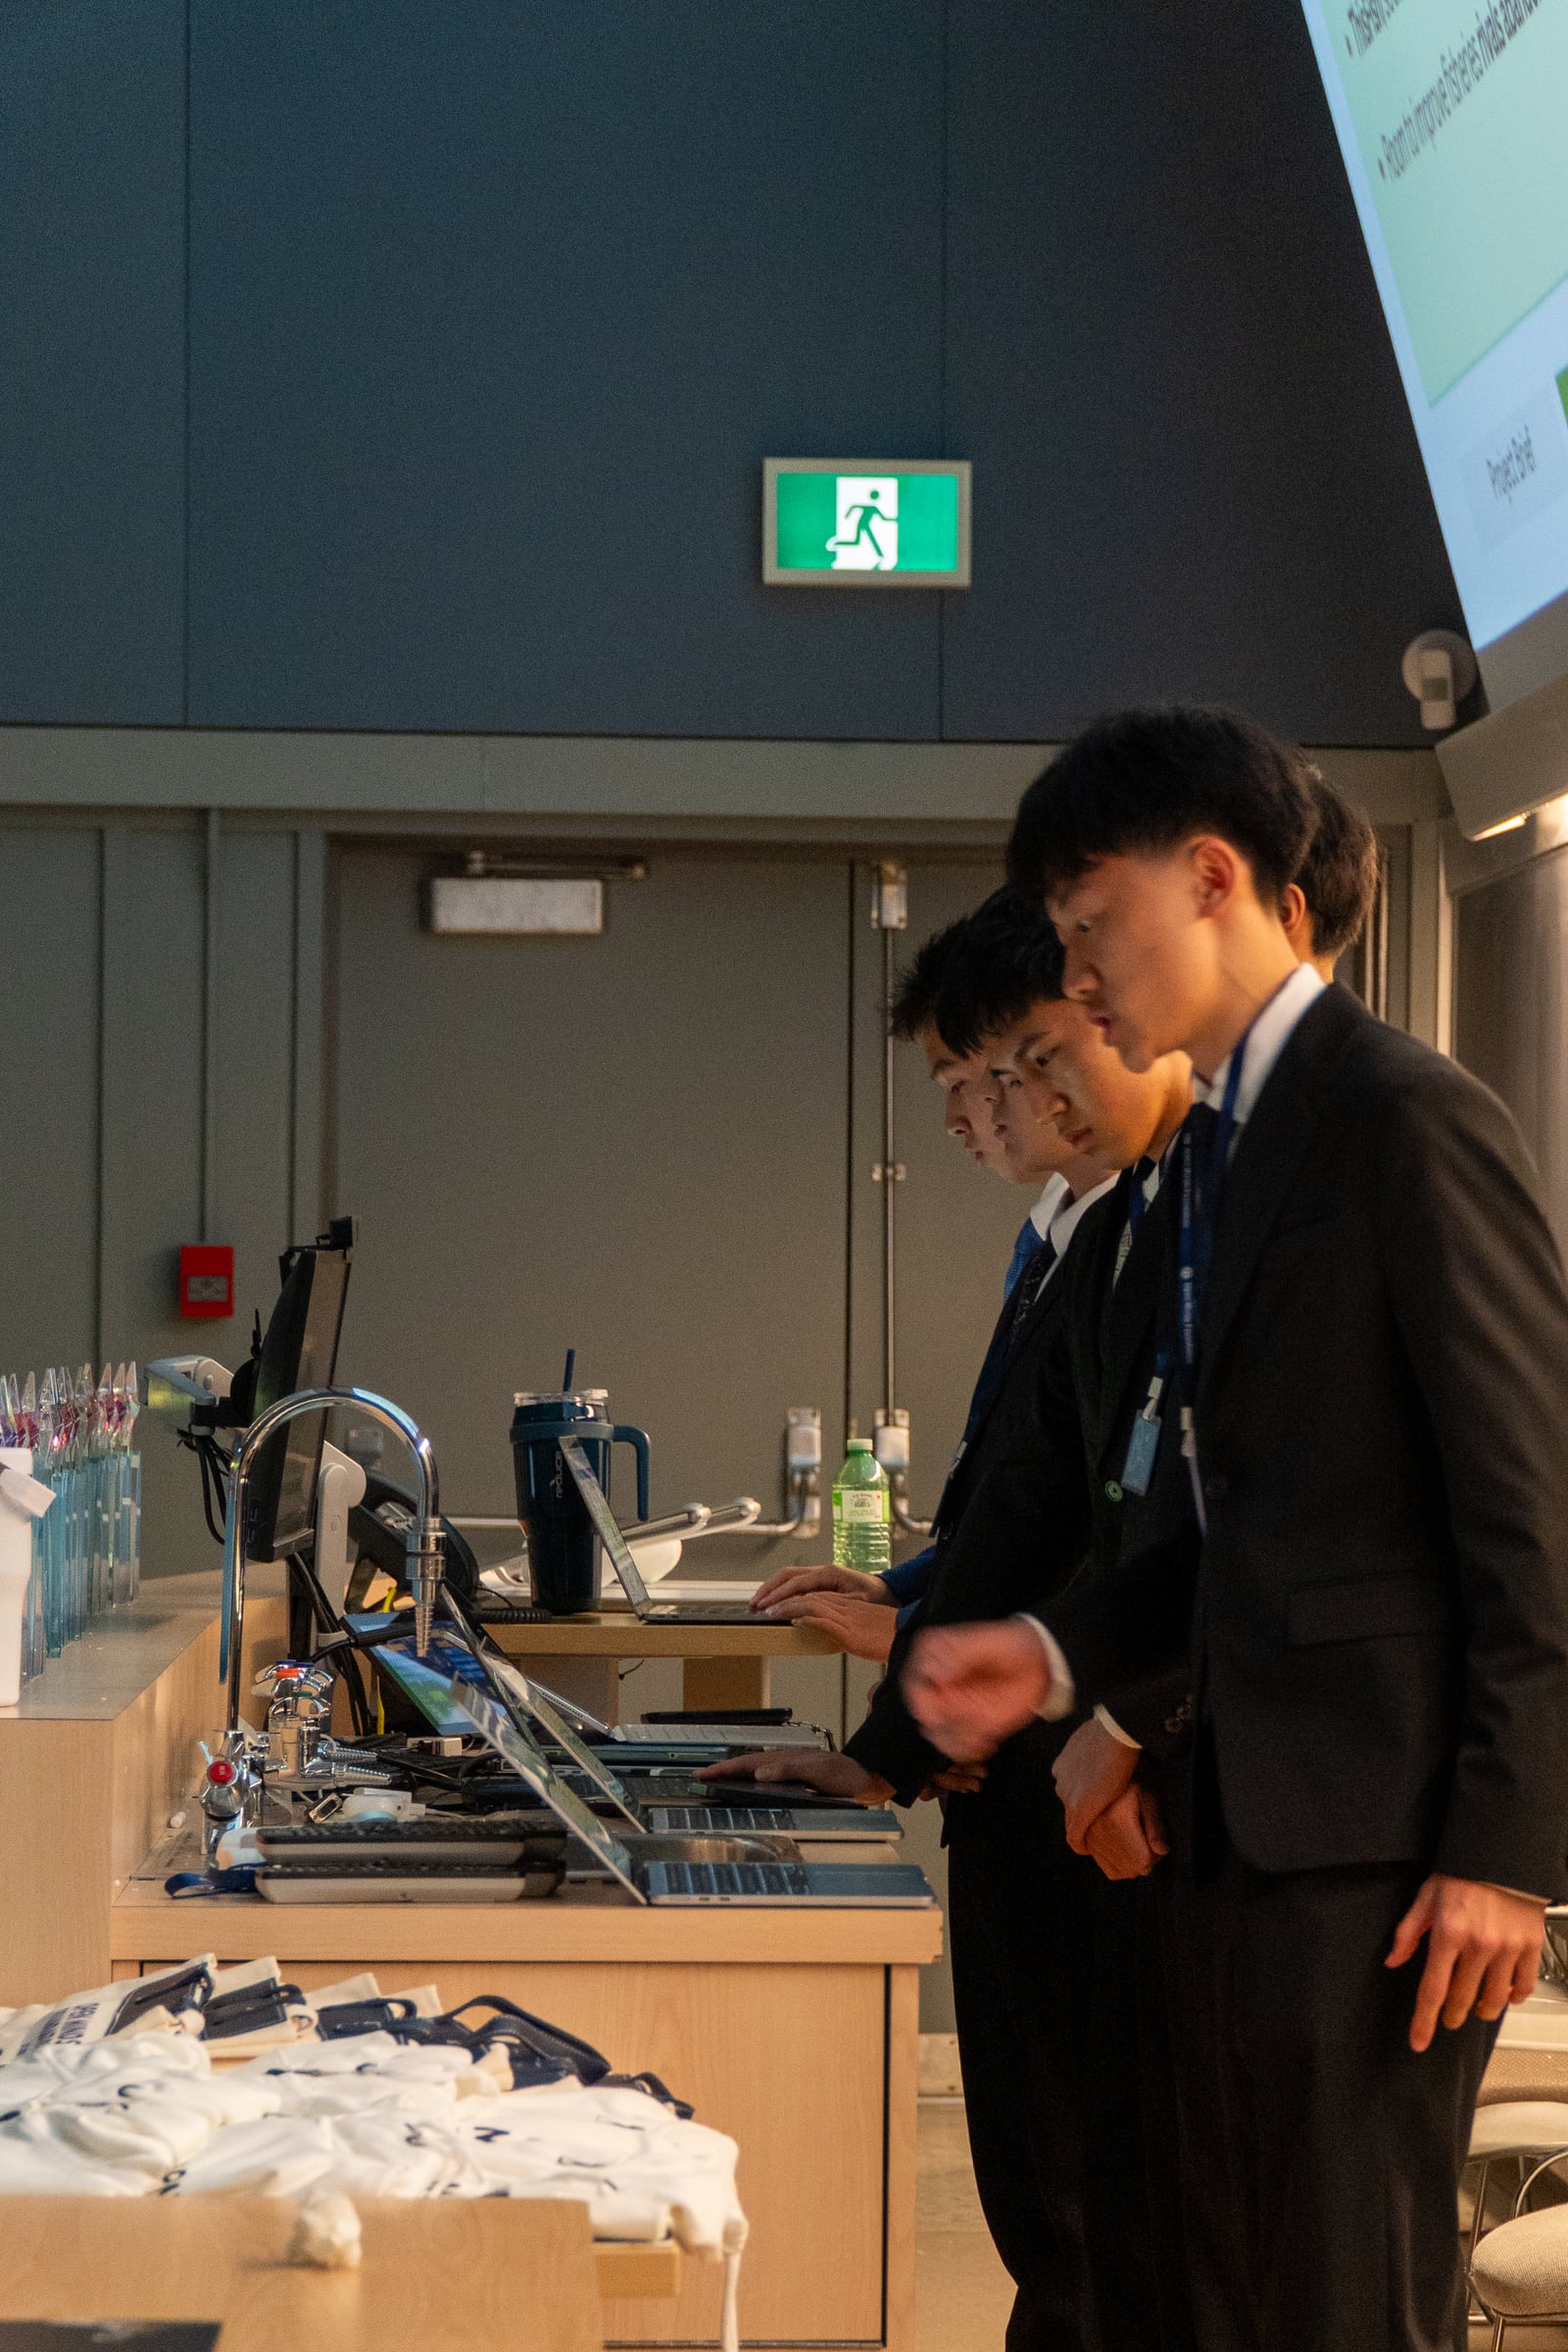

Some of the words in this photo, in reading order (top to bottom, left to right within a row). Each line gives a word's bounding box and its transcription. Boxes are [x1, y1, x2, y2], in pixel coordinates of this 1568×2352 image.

[1381, 125, 1411, 181] Room
[1408, 77, 1451, 152] improve
[1441, 31, 1484, 109] fisheries
[551, 1451, 563, 1497] reduce
